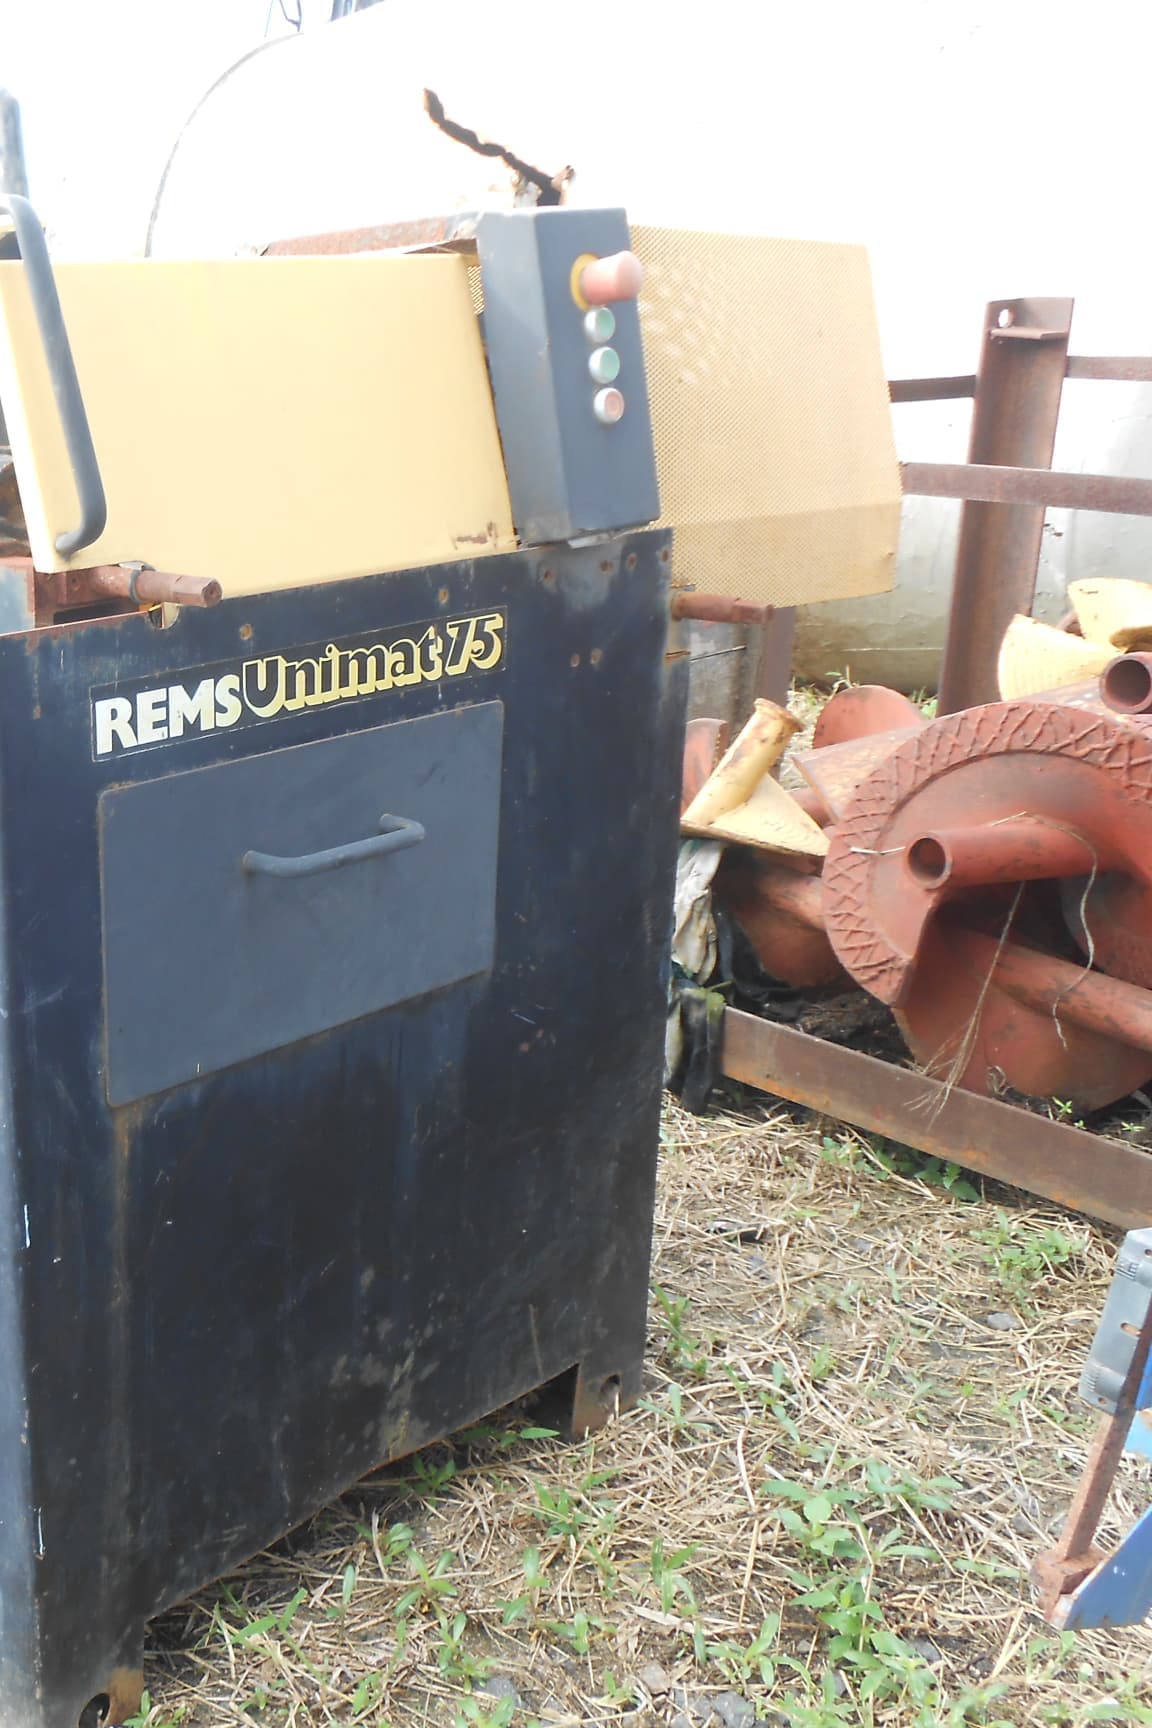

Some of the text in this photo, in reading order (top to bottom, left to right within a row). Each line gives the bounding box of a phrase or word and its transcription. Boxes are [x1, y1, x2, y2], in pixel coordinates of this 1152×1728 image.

[94, 612, 505, 755] REMS Unimat 75
